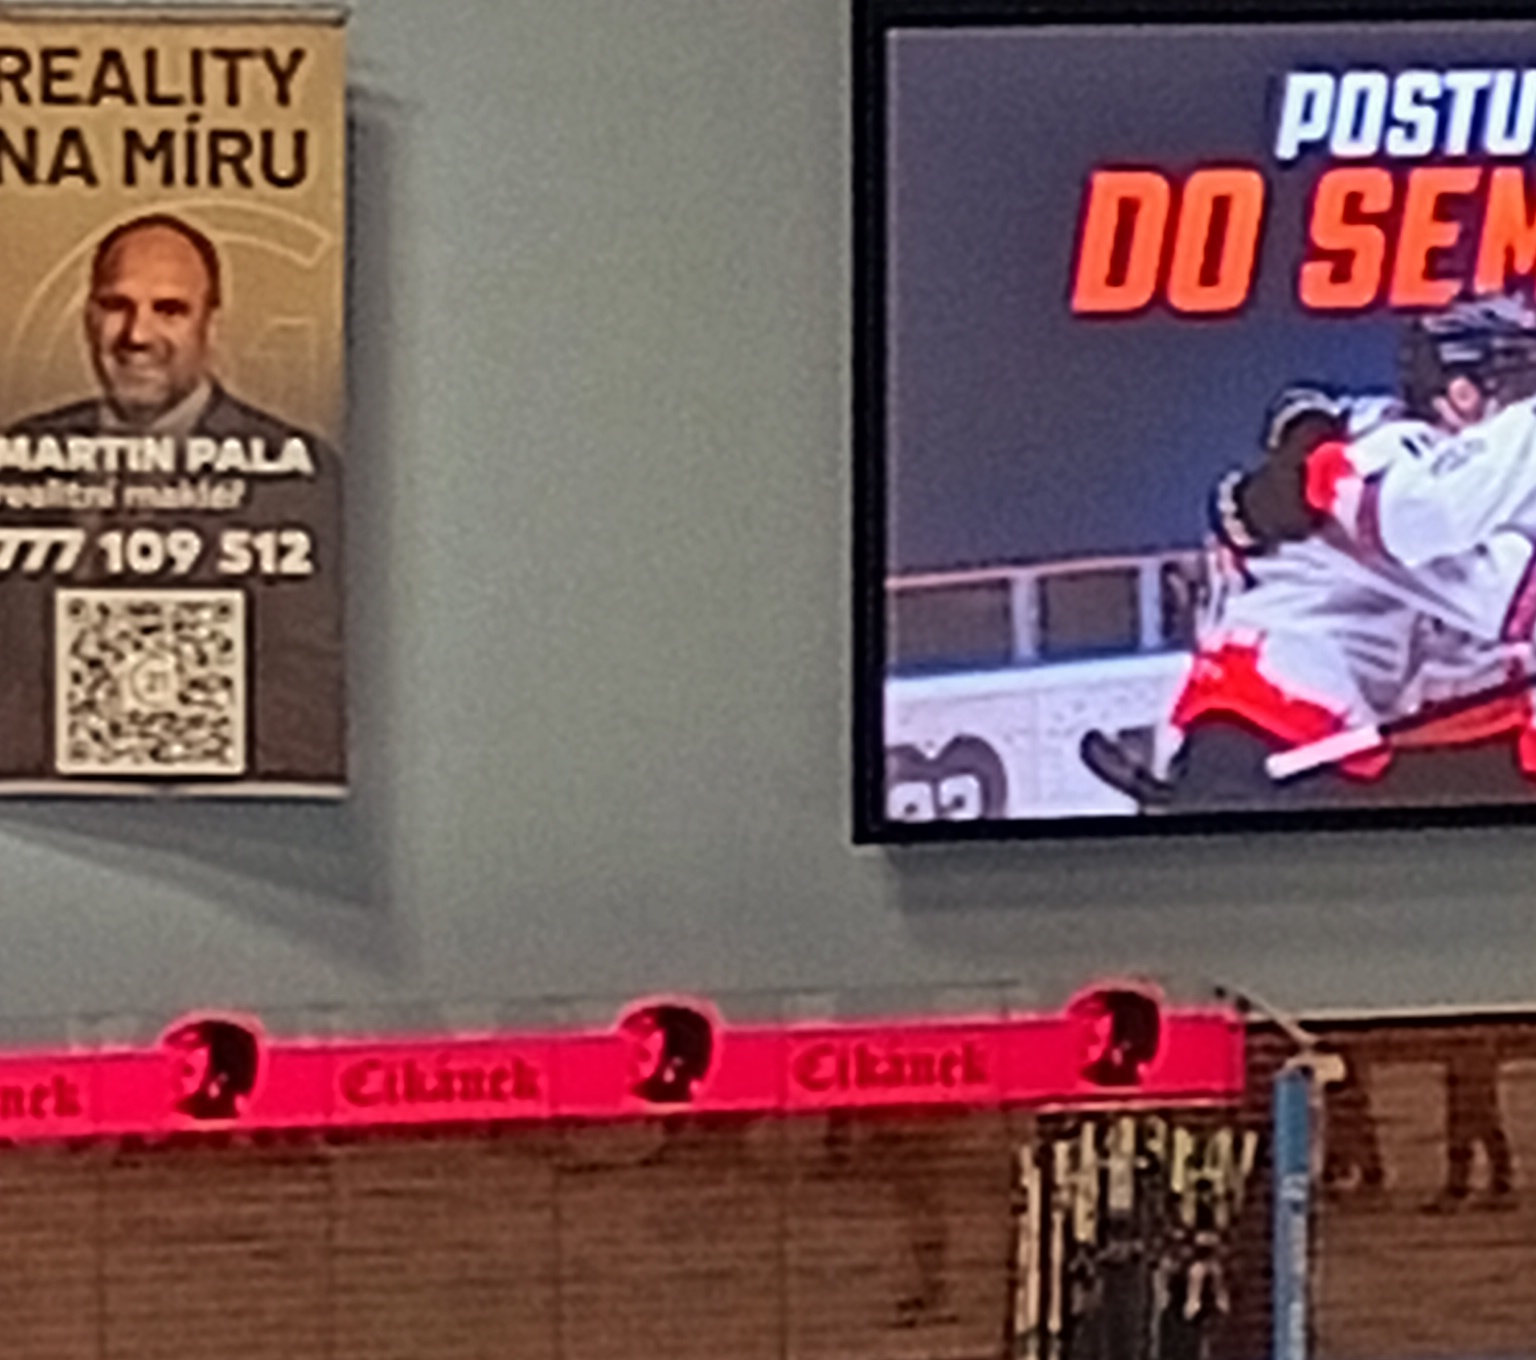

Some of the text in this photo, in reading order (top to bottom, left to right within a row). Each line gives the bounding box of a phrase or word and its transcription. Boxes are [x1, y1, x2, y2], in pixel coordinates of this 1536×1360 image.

[0, 47, 306, 107] REALITY
[0, 112, 309, 188] NA MÍRU
[1072, 168, 1266, 313] DO
[0, 436, 315, 475] MARTIN PALA
[0, 528, 314, 574] 777 109 512
